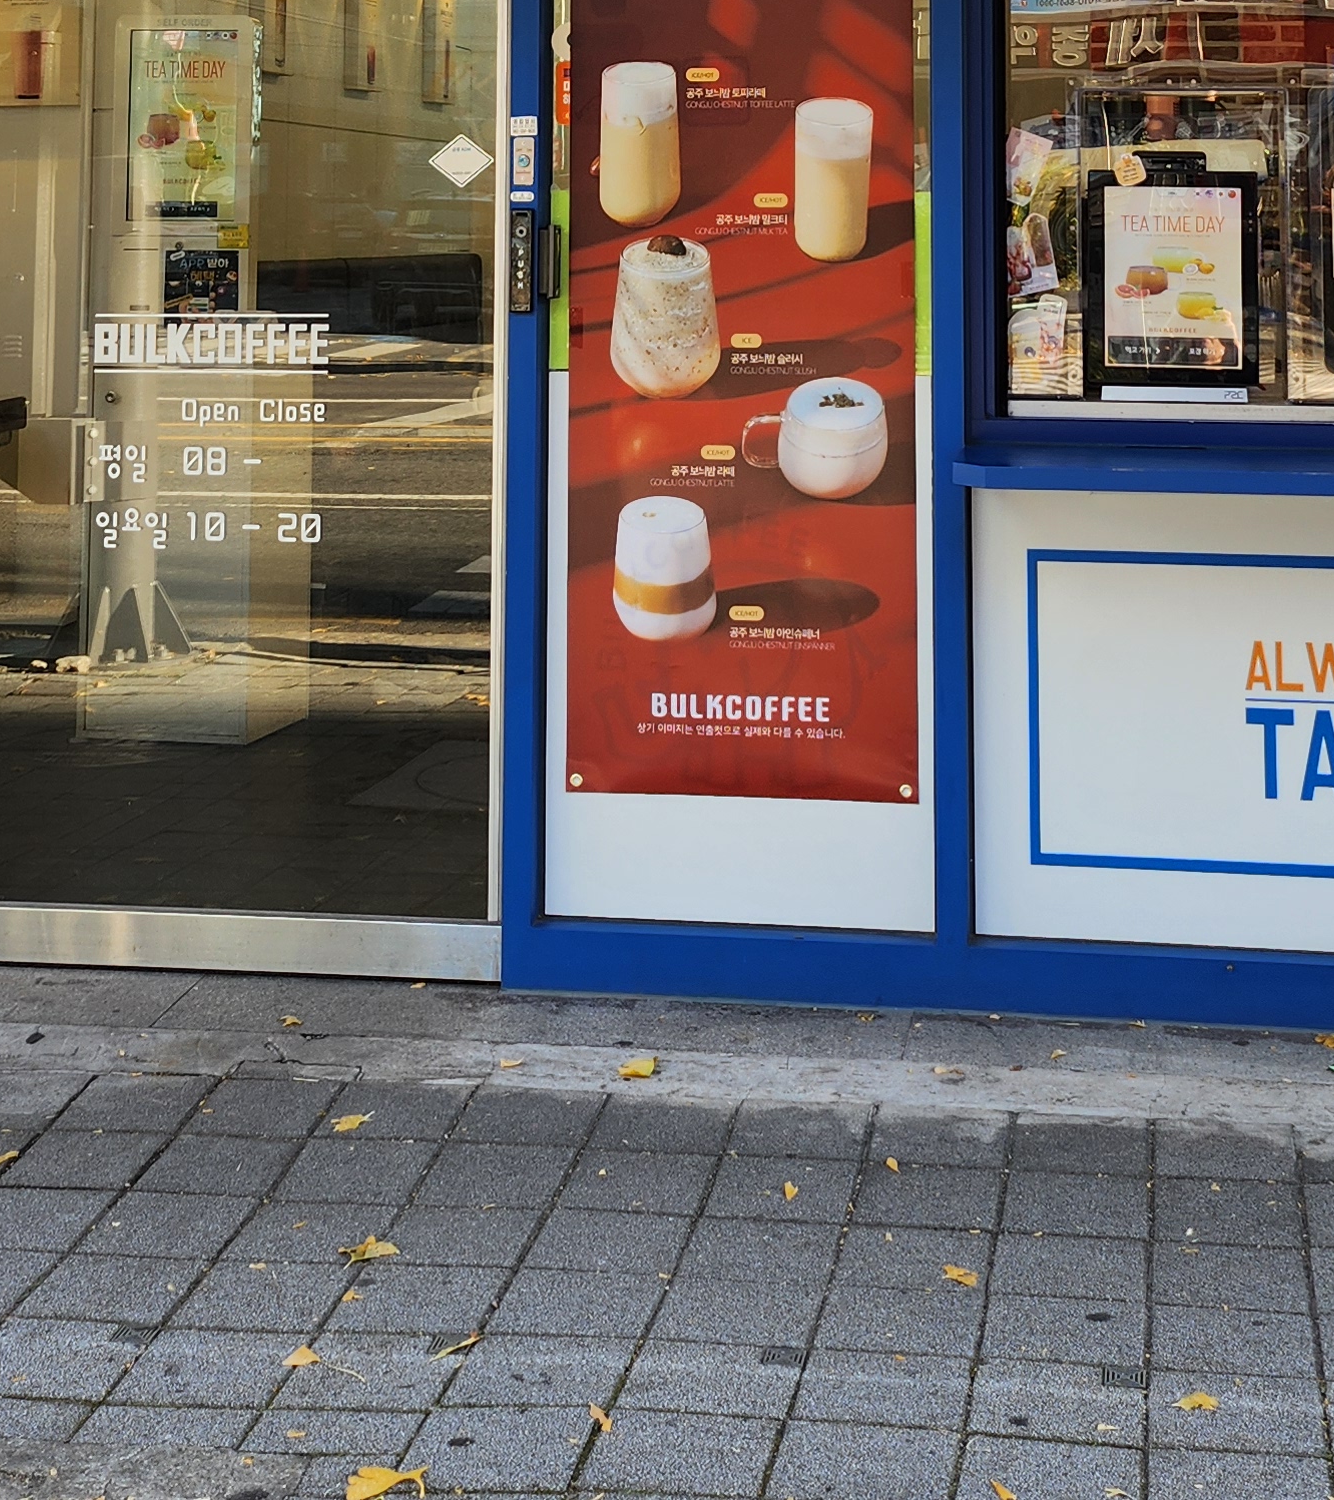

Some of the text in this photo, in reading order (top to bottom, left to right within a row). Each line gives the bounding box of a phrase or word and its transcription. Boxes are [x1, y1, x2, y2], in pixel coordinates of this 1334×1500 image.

[1121, 215, 1225, 233] TEA TIME DAY
[94, 323, 329, 364] BULKCOFFEE
[181, 398, 326, 427] Open Close
[98, 444, 227, 483] 평일 08
[651, 692, 830, 723] BULKCOFFEE
